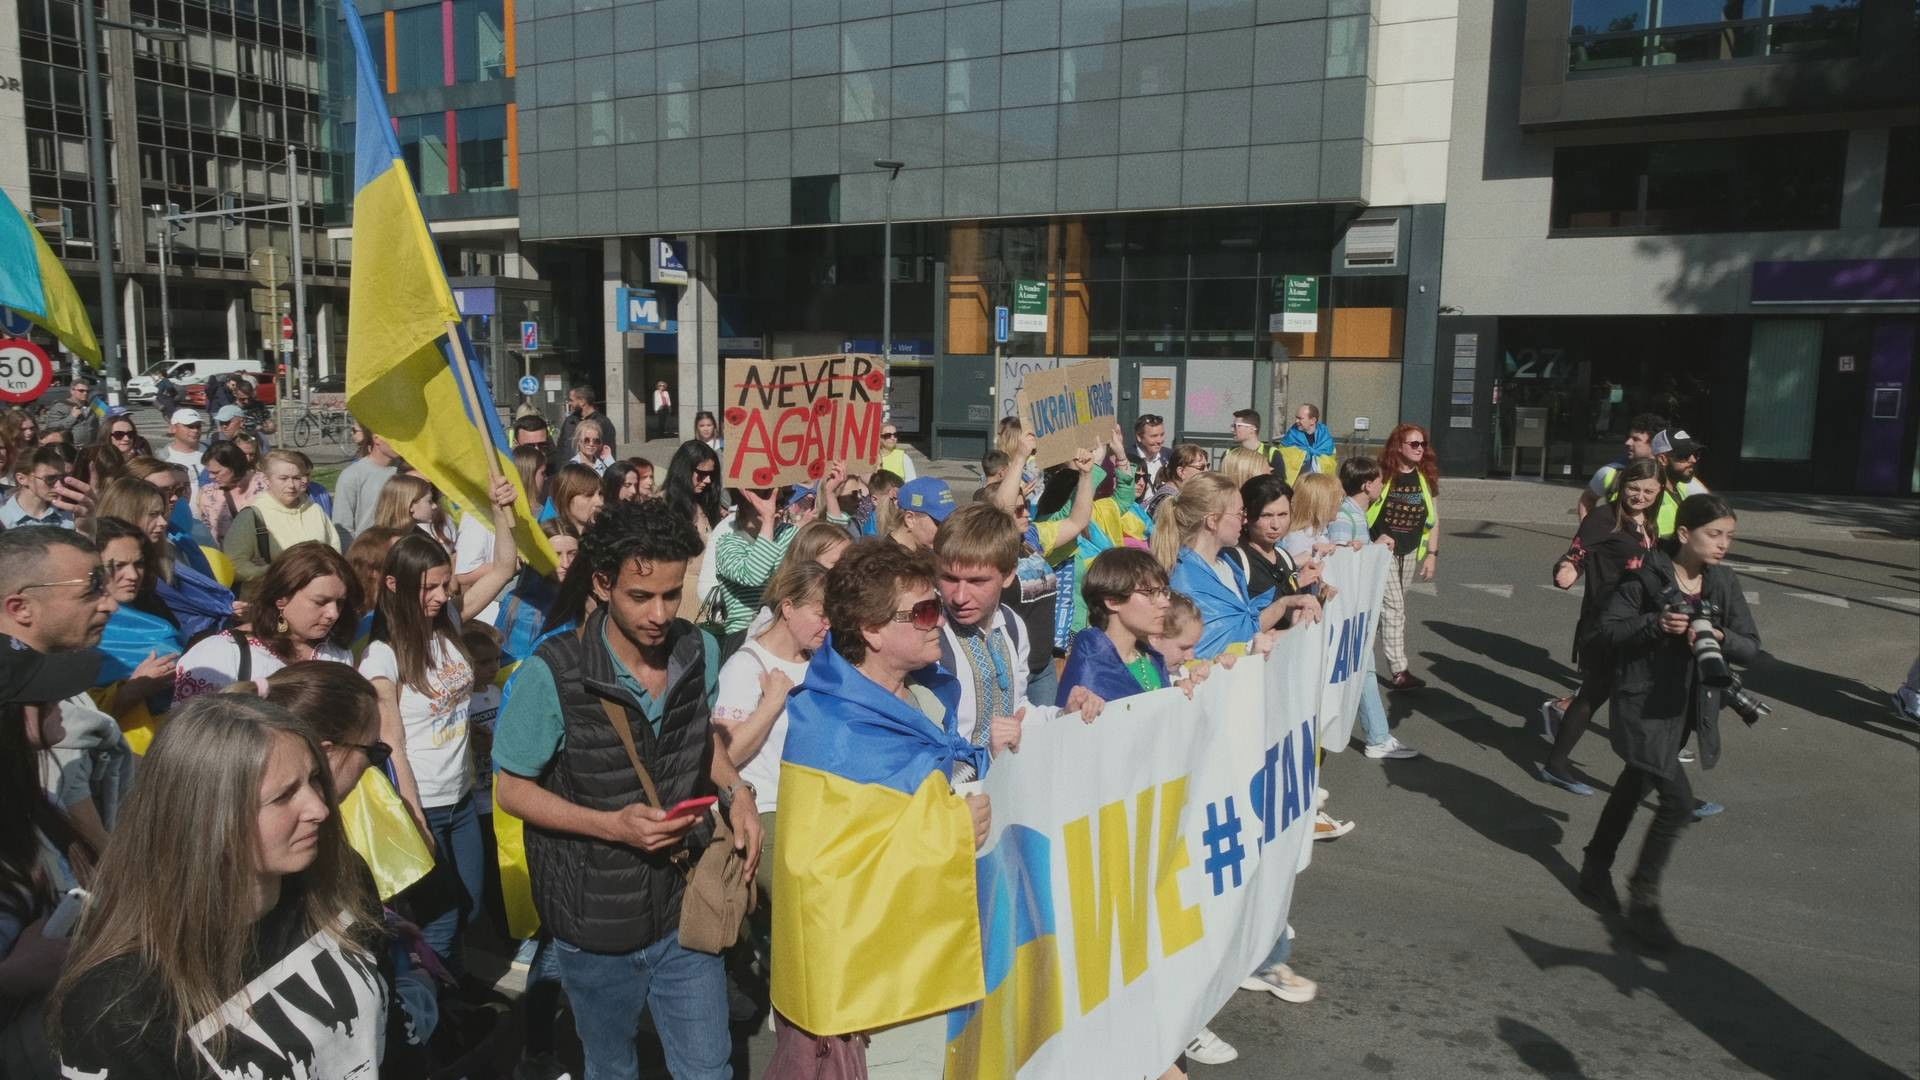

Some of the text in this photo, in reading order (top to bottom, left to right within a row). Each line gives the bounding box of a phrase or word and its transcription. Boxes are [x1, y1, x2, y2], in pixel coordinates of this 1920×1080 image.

[629, 299, 659, 323] M
[0, 356, 34, 378] 50
[1514, 347, 1562, 378] 27
[7, 379, 28, 389] km
[738, 356, 873, 410] NEVER
[1063, 773, 1204, 1017] WE
